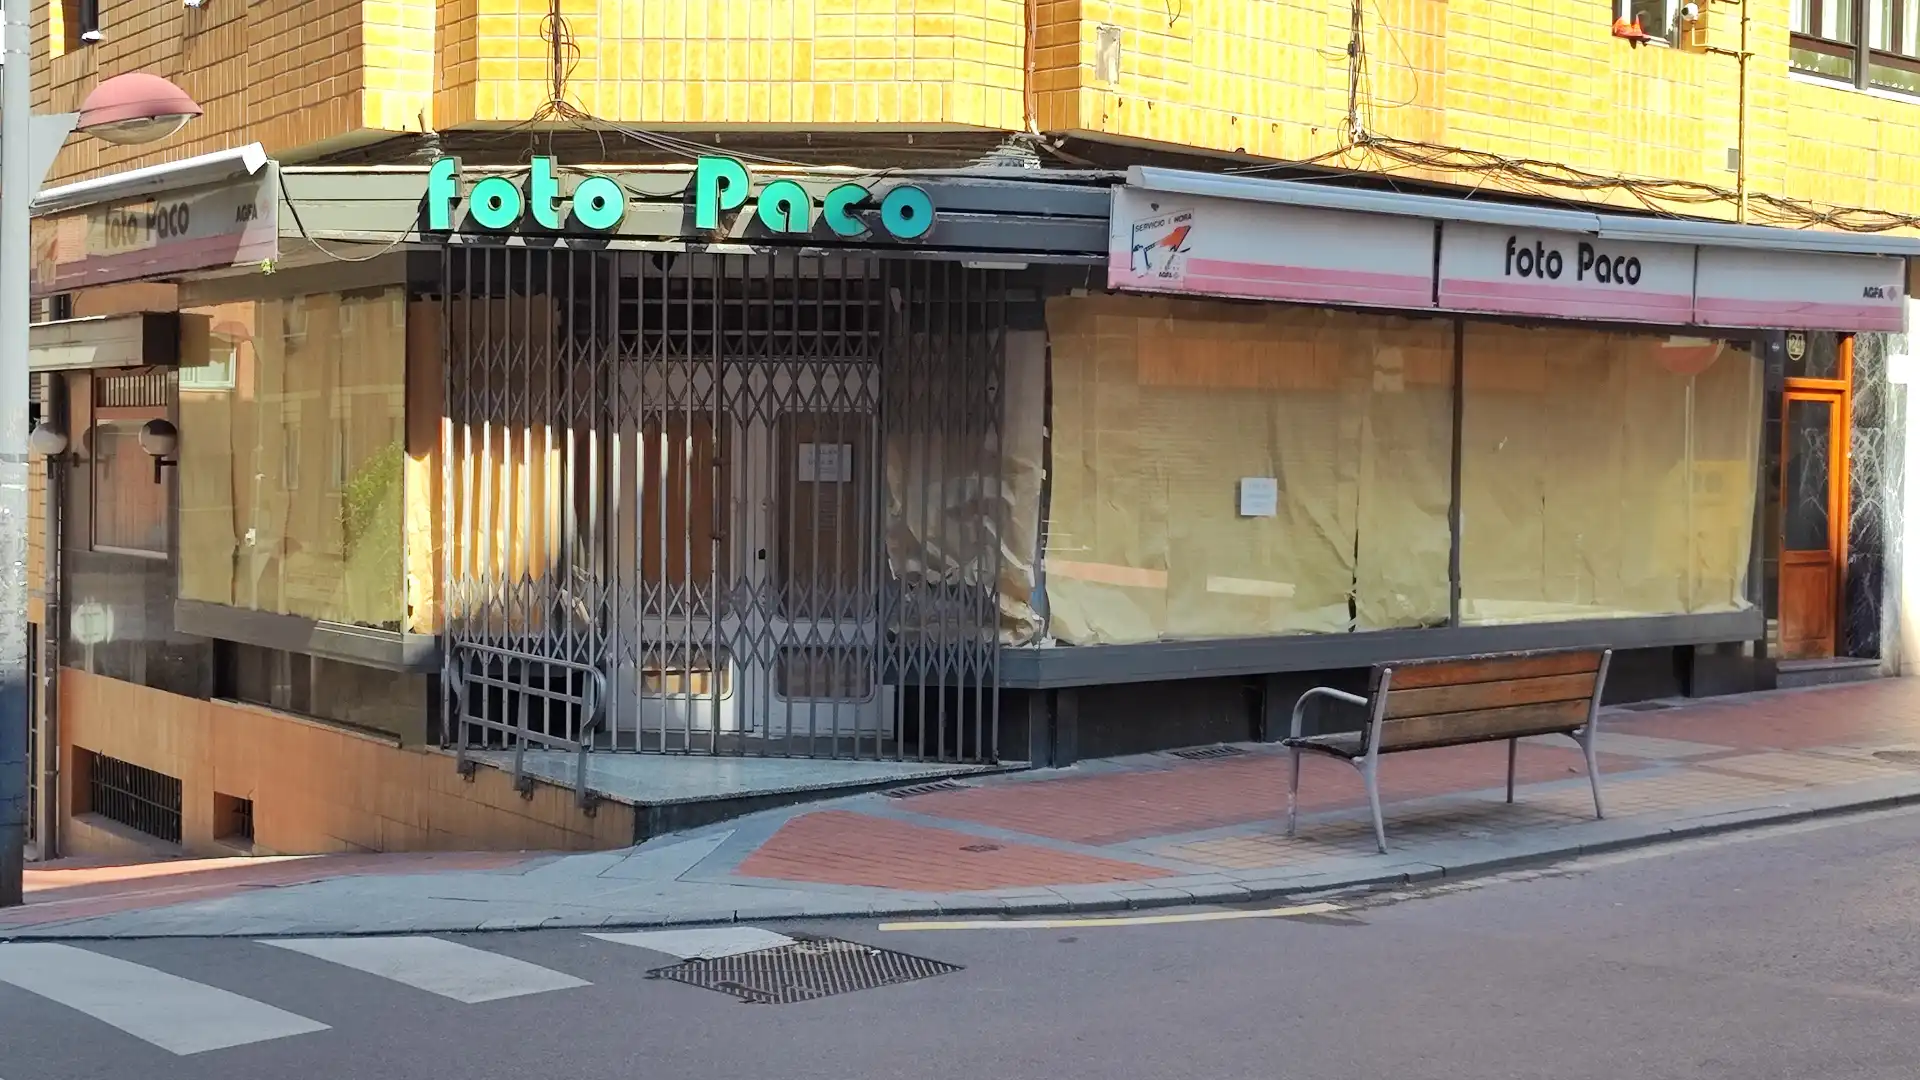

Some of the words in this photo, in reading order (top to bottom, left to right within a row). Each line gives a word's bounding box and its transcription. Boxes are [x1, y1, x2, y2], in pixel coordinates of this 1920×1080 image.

[428, 156, 624, 230] foto
[696, 156, 935, 238] Paco
[235, 204, 258, 223] AGFA
[1135, 219, 1165, 233] SERVICIO
[1174, 213, 1192, 223] HORA
[1505, 235, 1563, 280] foto
[1577, 242, 1641, 285] Paco
[1862, 286, 1884, 299] AGFA
[1790, 334, 1803, 352] 24
